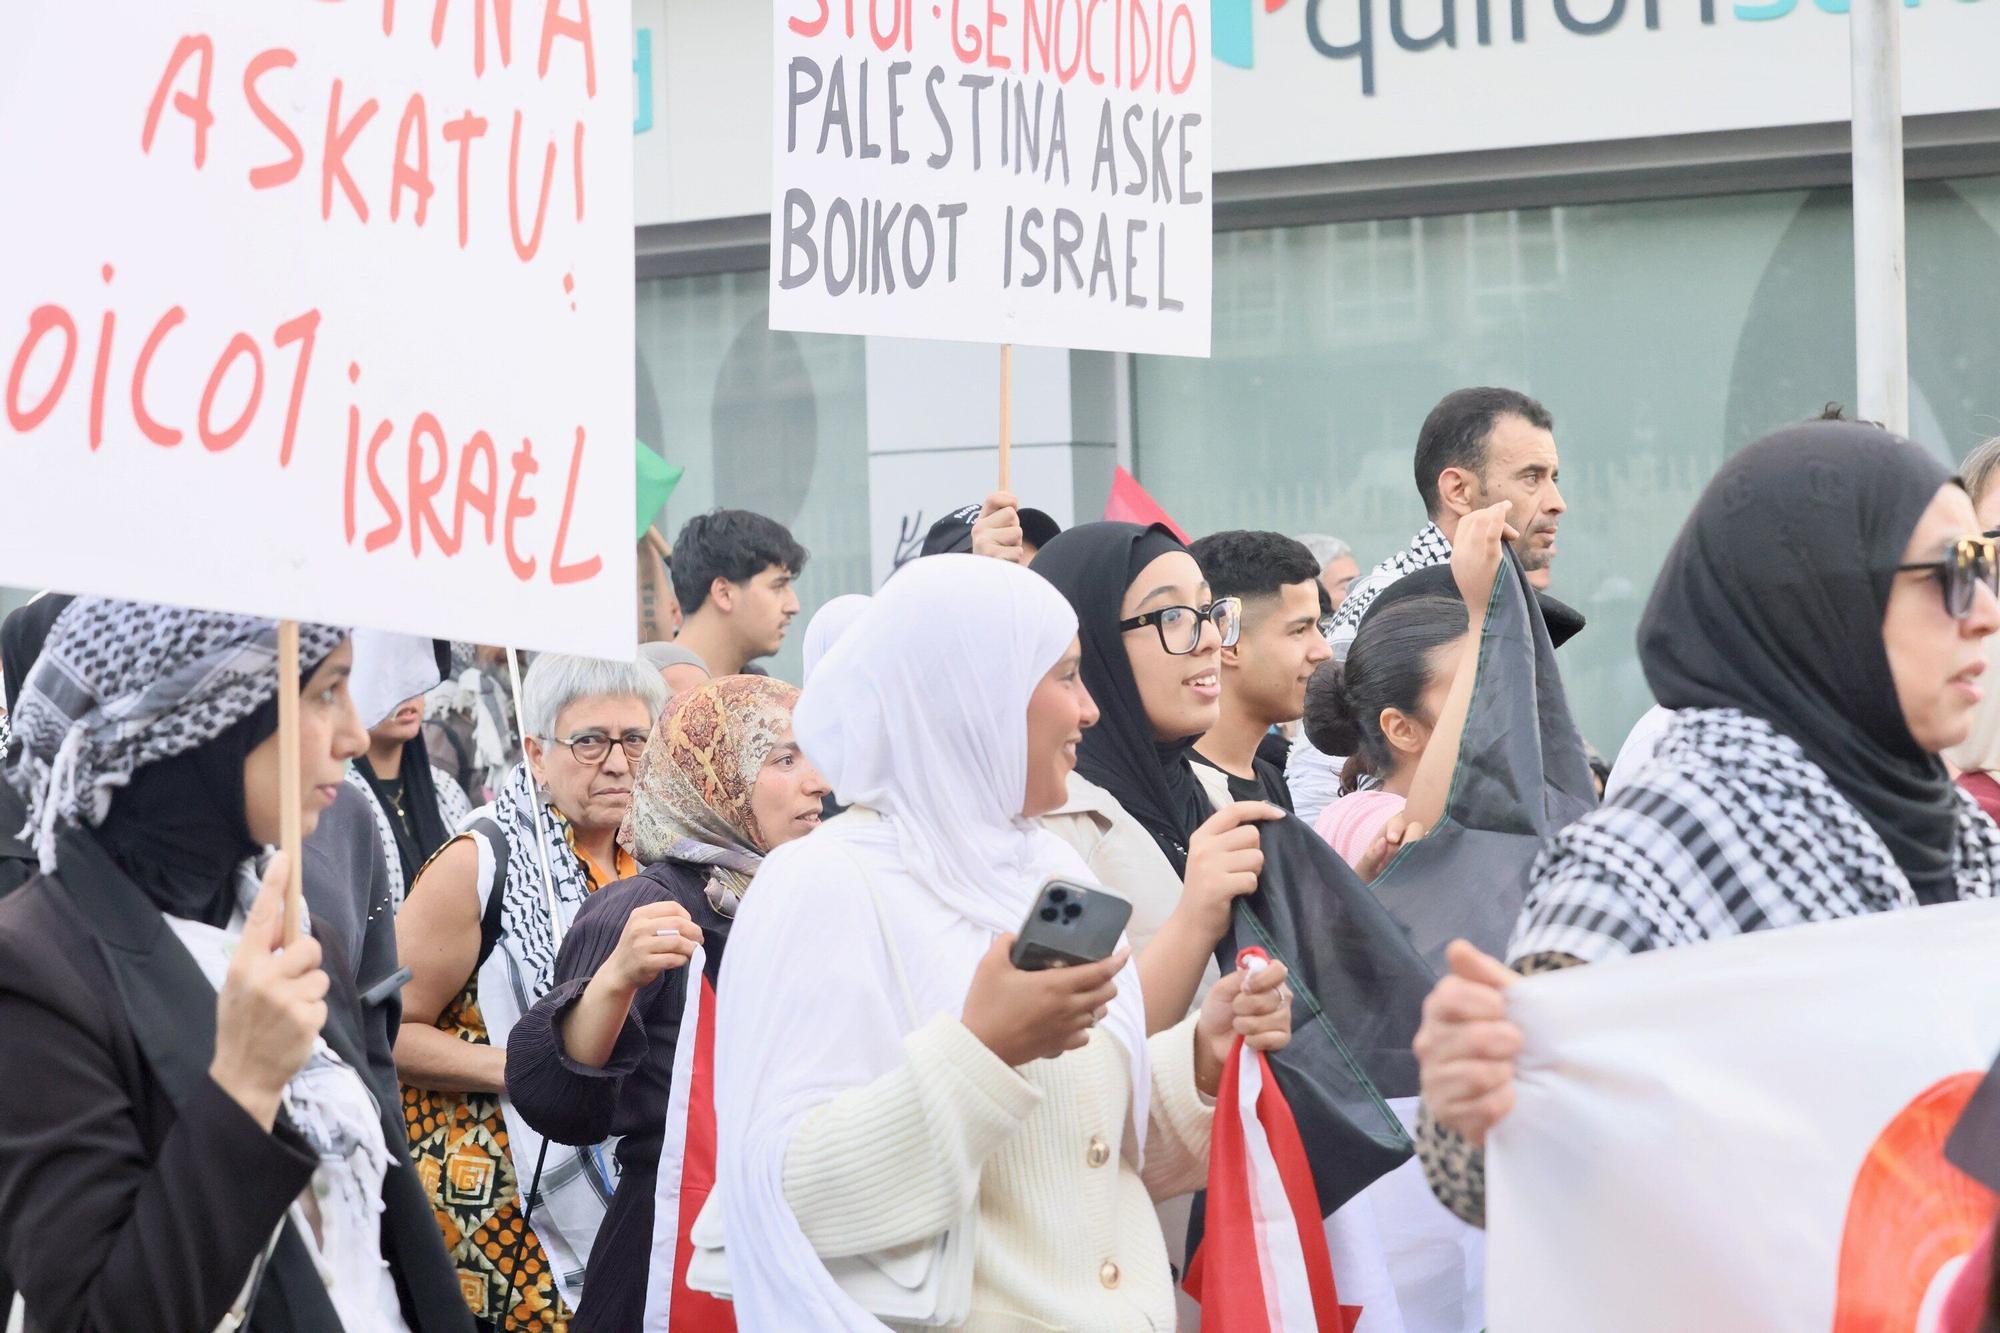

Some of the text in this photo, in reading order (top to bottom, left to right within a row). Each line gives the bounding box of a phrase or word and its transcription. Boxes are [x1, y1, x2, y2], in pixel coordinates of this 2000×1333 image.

[951, 0, 1197, 95] GENOCIDIO
[788, 55, 1070, 186] PALESTINA
[1091, 98, 1203, 205] ASKE
[779, 188, 1184, 312] BOIKOT ISRAEL
